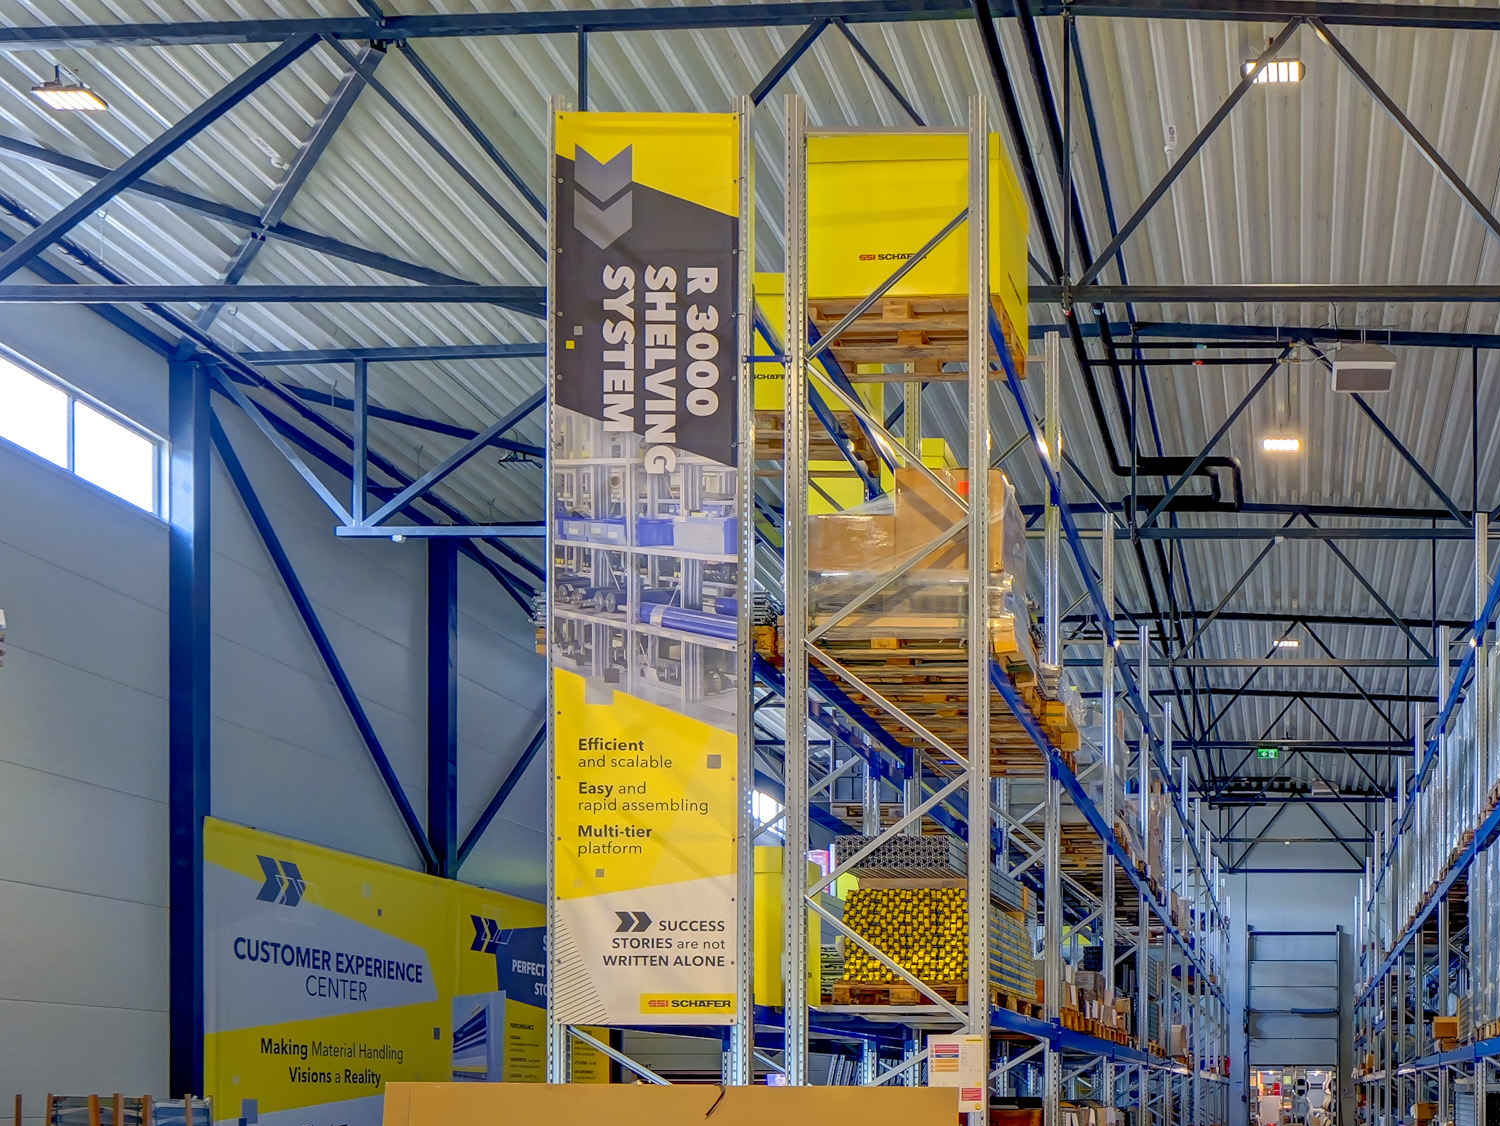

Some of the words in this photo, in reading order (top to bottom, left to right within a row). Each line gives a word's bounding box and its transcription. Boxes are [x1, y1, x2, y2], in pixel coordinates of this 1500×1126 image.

[687, 267, 718, 296] R
[602, 264, 635, 432] SYSTEM
[644, 264, 677, 474] SHELVING
[686, 304, 719, 417] 3000
[578, 737, 645, 751] Efficient
[578, 754, 606, 768] and
[610, 754, 673, 768] scalable
[578, 781, 614, 798] Easy
[618, 781, 647, 794] and
[578, 798, 617, 814] rapid
[622, 798, 709, 815] assembling
[578, 825, 652, 838] Multi-tier
[578, 841, 642, 857] platform
[658, 920, 725, 932] SUCCESS
[612, 938, 673, 949] STORIES
[677, 940, 699, 949] are
[703, 939, 726, 949] not
[233, 936, 331, 972] CUSTOMER
[335, 951, 423, 984] EXPERIENCE
[511, 959, 546, 977] PERFECT
[602, 955, 669, 967] WRITTEN
[673, 955, 725, 967] ALONE
[305, 974, 368, 1001] CENTER
[647, 1000, 669, 1008] SSI
[260, 1037, 308, 1060] Making
[312, 1040, 356, 1058] Material
[358, 1043, 404, 1064] Handling
[288, 1067, 332, 1083] Visions
[335, 1073, 341, 1083] a
[344, 1068, 381, 1088] Reality
